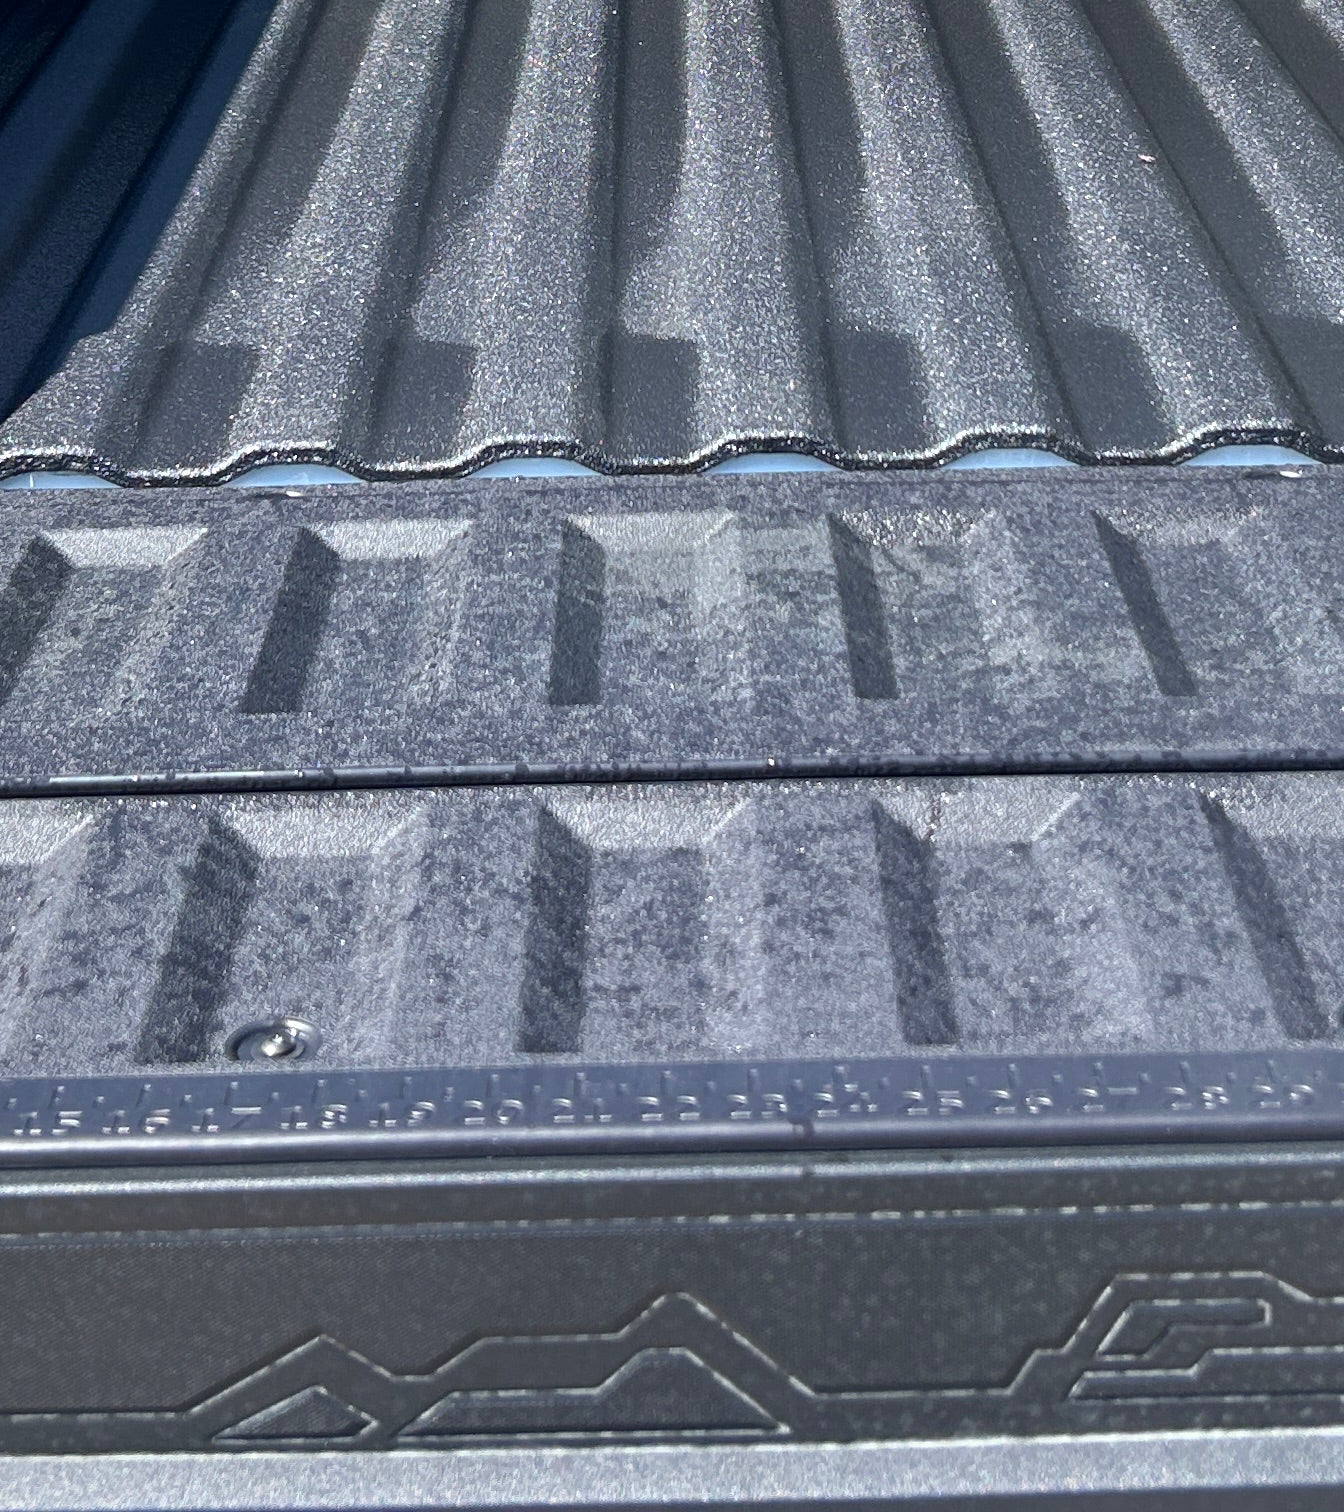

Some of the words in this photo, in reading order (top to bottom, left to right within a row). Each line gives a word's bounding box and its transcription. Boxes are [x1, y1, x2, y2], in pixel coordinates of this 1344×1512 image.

[13, 1110, 84, 1136] 15
[101, 1108, 171, 1134] 16
[191, 1106, 262, 1132] 17
[281, 1104, 349, 1129] 18
[368, 1101, 436, 1128] 19
[462, 1099, 524, 1125] 20
[552, 1097, 612, 1123] 21
[636, 1095, 701, 1121] 22
[726, 1092, 788, 1119] 23
[814, 1091, 878, 1117] 24
[901, 1090, 964, 1115] 25
[987, 1089, 1054, 1115] 26
[1076, 1087, 1139, 1111] 27
[1164, 1085, 1231, 1110] 28
[1253, 1083, 1315, 1108] 29
